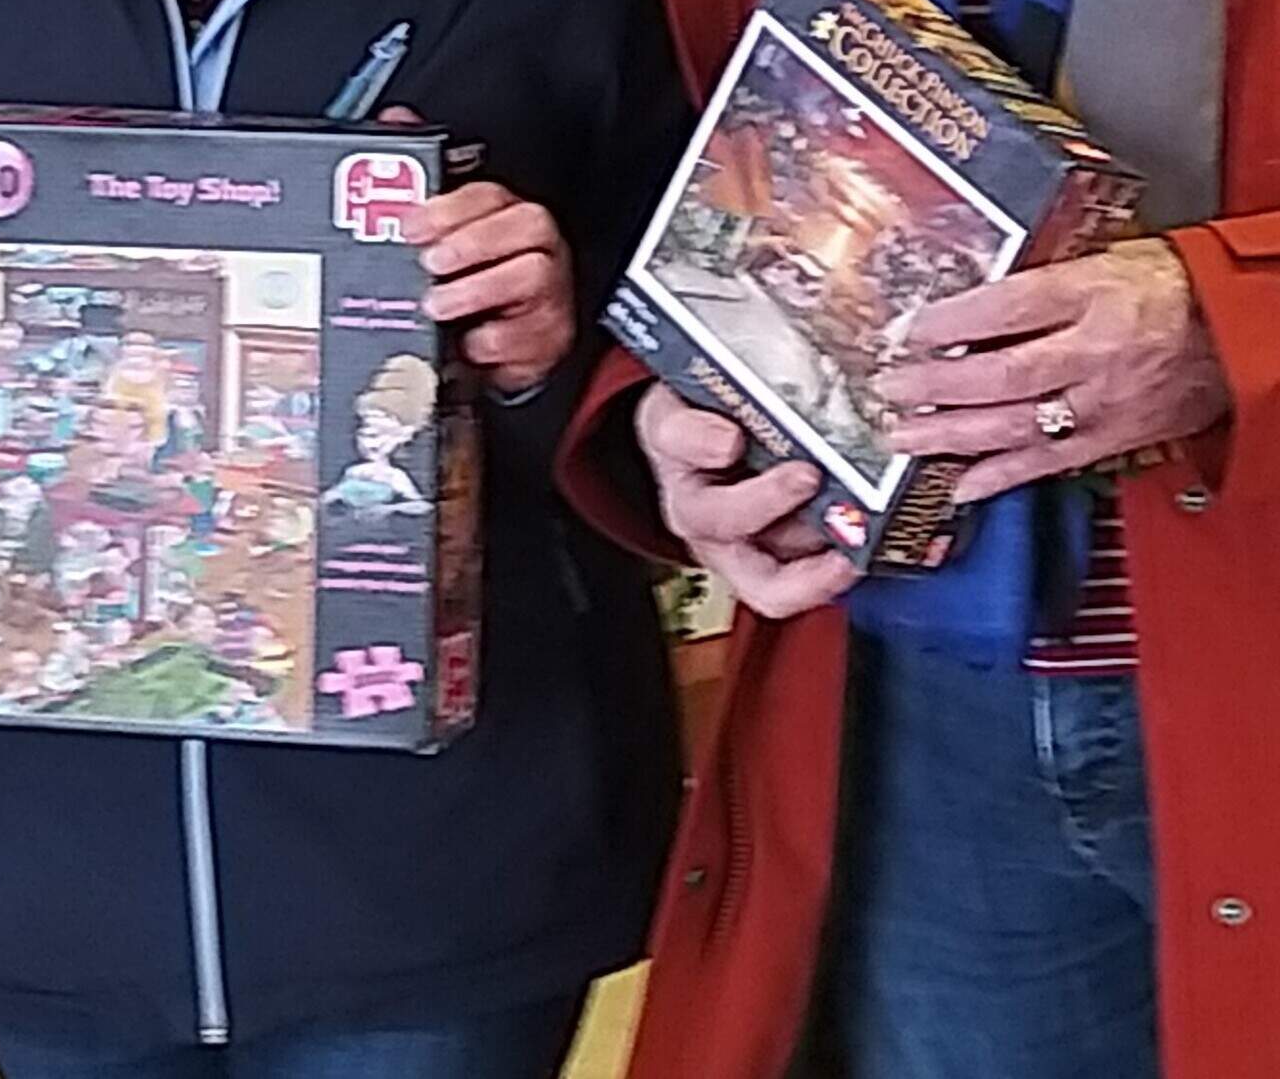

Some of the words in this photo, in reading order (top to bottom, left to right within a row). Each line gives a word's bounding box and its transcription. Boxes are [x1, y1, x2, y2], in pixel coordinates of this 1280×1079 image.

[828, 25, 980, 163] COLLECTION
[86, 173, 142, 200] The
[145, 175, 195, 207] Toy
[196, 177, 282, 209] Shop!
